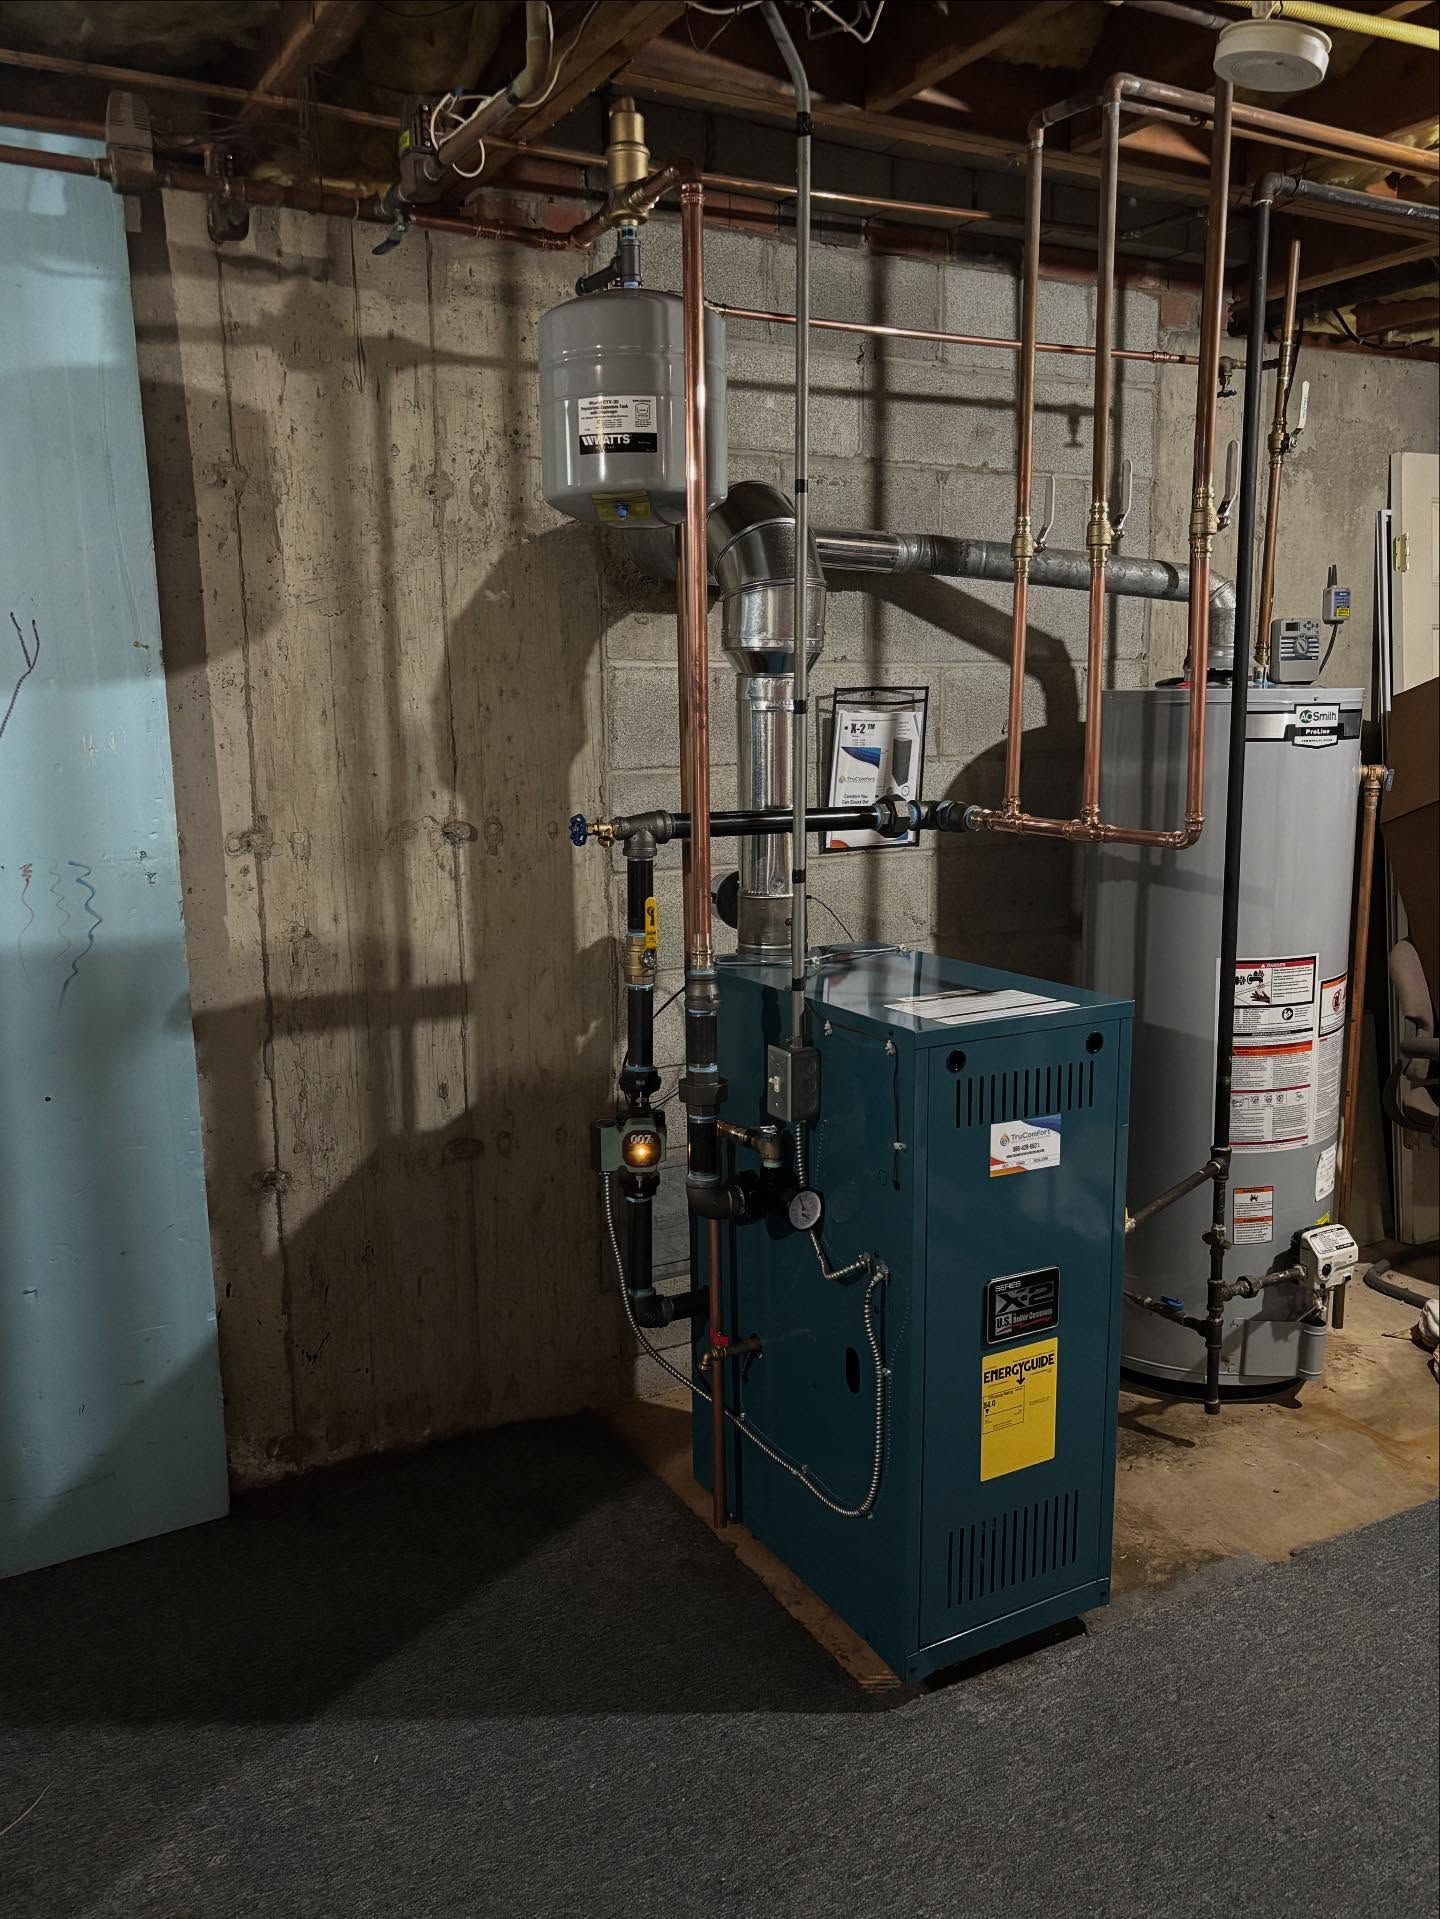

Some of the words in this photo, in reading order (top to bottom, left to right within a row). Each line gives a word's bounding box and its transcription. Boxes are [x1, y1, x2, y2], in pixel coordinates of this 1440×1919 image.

[582, 434, 630, 446] WATTS
[850, 724, 866, 734] X-2
[1011, 1128, 1050, 1141] TruComfort
[995, 1281, 1021, 1292] SERIES
[984, 1354, 1054, 1384] ENERGYGUIDE
